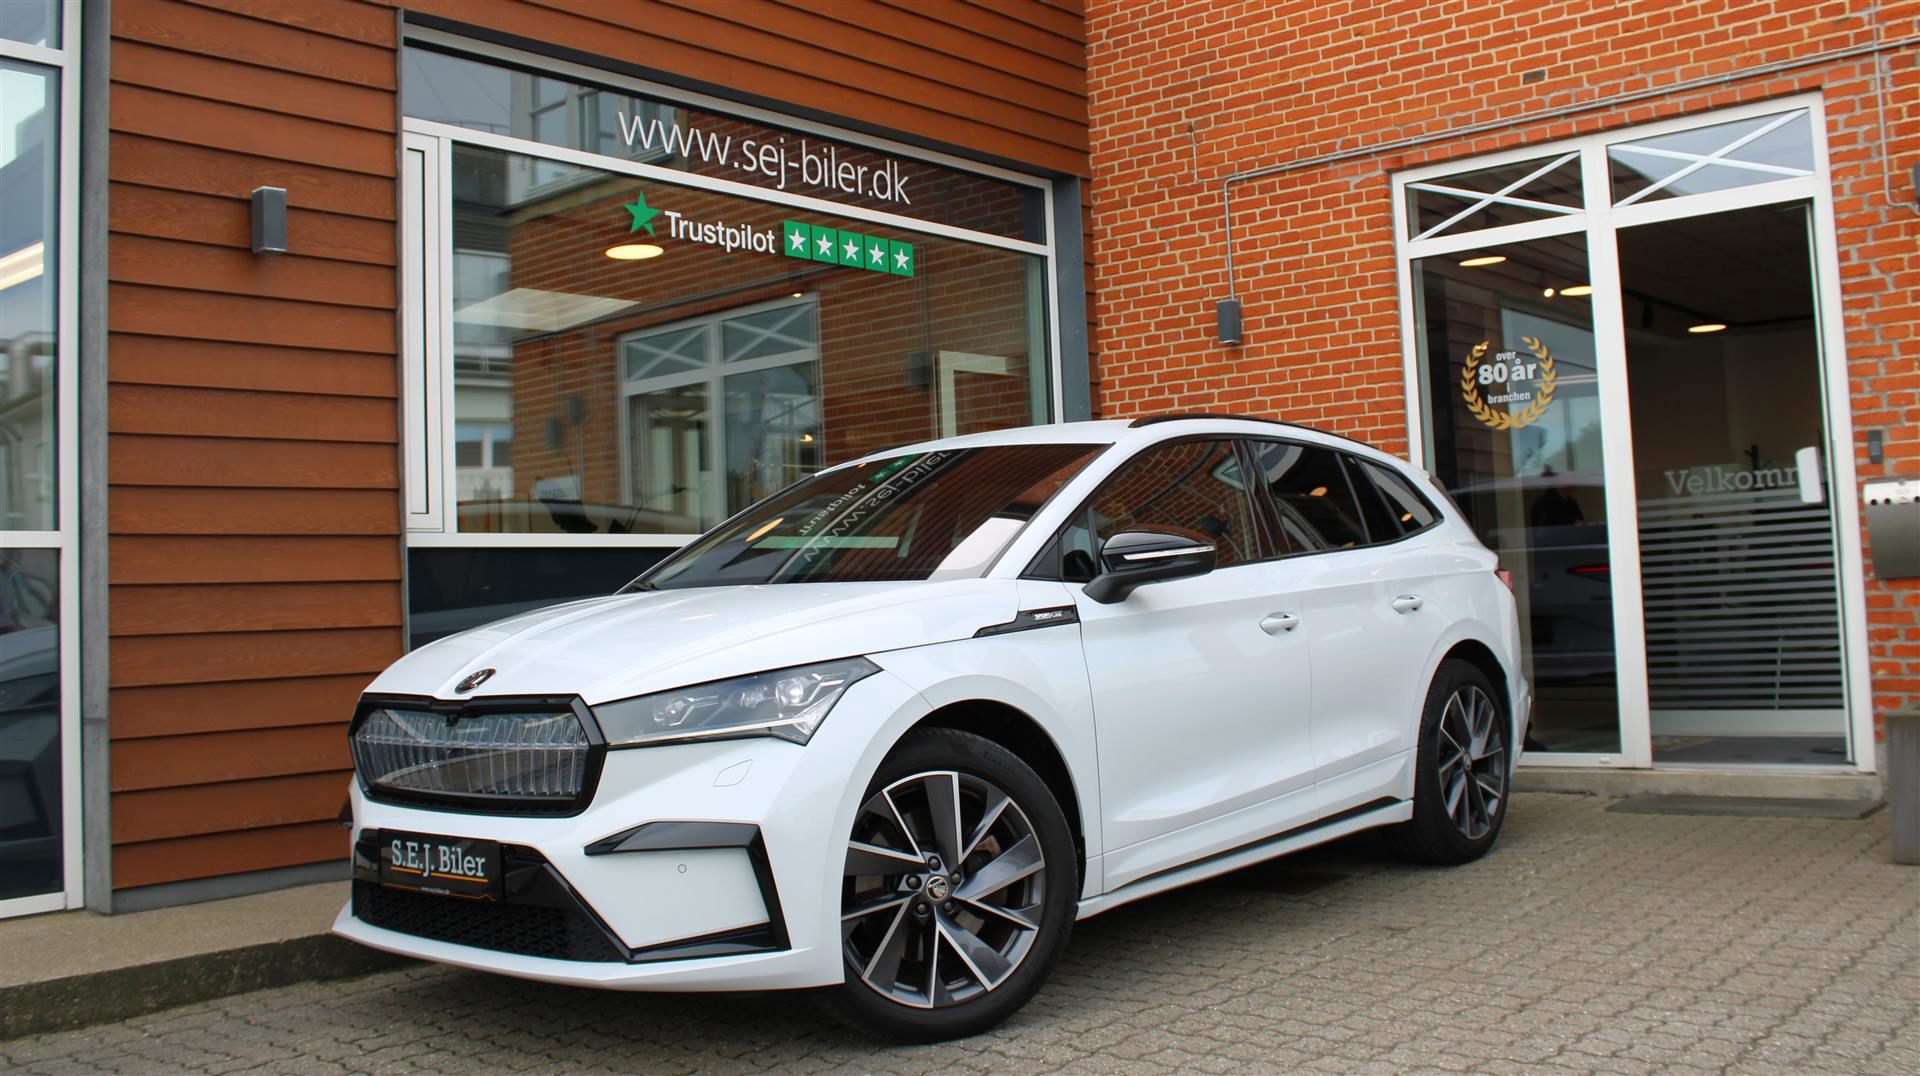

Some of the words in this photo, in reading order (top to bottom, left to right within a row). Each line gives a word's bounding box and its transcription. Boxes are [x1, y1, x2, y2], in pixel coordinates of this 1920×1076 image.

[618, 111, 911, 205] www.sej-biler.dk
[664, 210, 776, 254] Trustpilot
[1478, 362, 1508, 385] 80
[1511, 358, 1536, 381] år
[1496, 351, 1516, 361] over
[1487, 392, 1531, 404] branchen
[391, 839, 435, 878] S.E.J.
[438, 845, 486, 877] Biler
